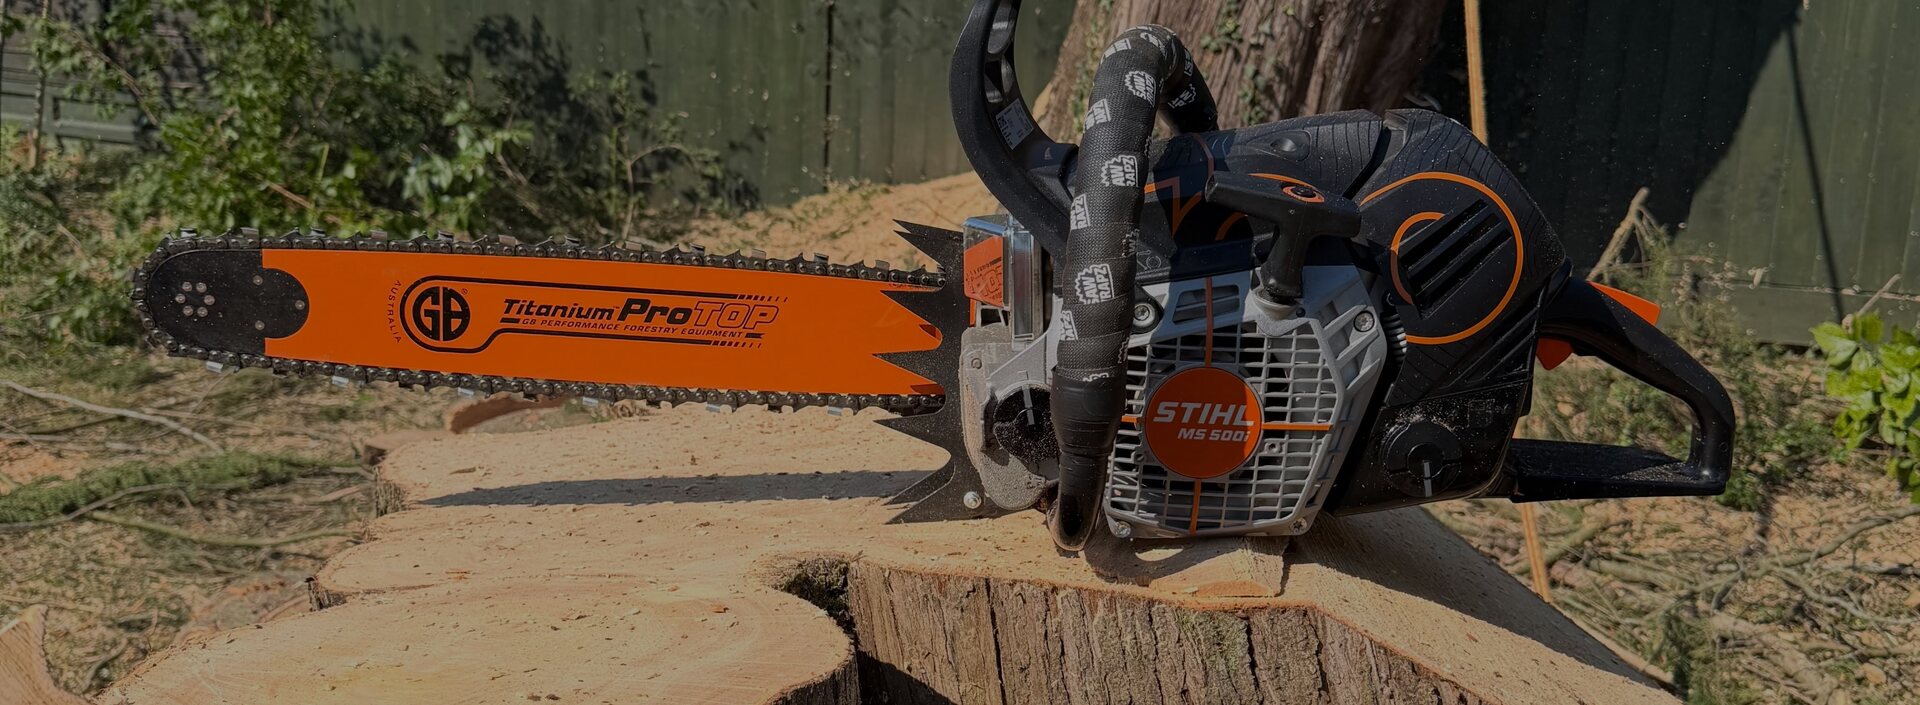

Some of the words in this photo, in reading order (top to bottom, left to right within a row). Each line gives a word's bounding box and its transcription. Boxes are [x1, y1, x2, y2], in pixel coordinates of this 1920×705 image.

[387, 280, 401, 343] AUSTRALIA
[412, 286, 470, 341] GB
[504, 299, 614, 320] Titanium
[541, 319, 620, 331] PERFORMANCE
[623, 324, 678, 334] FORESTRY
[681, 328, 742, 338] EQUIPMENT
[1153, 401, 1254, 426] STIHL
[1177, 428, 1207, 440] MS
[1209, 429, 1250, 442] 500i
